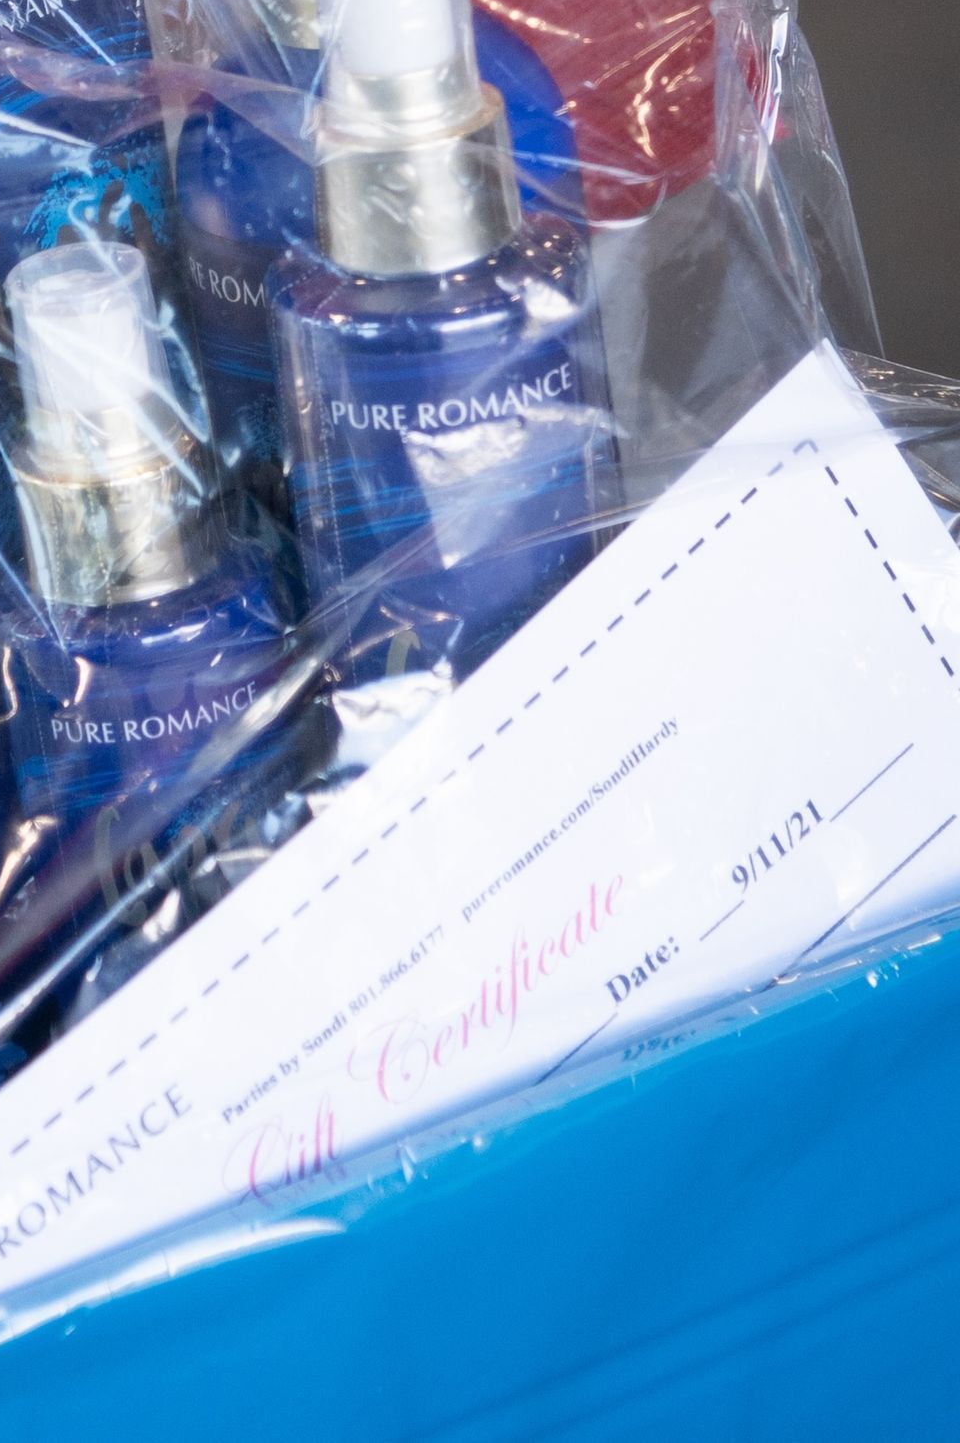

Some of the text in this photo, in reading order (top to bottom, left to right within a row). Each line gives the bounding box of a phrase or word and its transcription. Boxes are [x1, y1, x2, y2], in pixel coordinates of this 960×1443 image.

[331, 362, 574, 431] PURE ROMANCE
[51, 680, 257, 744] PURE ROMANCE
[221, 717, 680, 1125] Parties by Sondi 801.866.6177 pureromance.com/SondiHardy
[347, 874, 624, 1104] Certificate
[604, 798, 826, 1004] Date: 9/11/21
